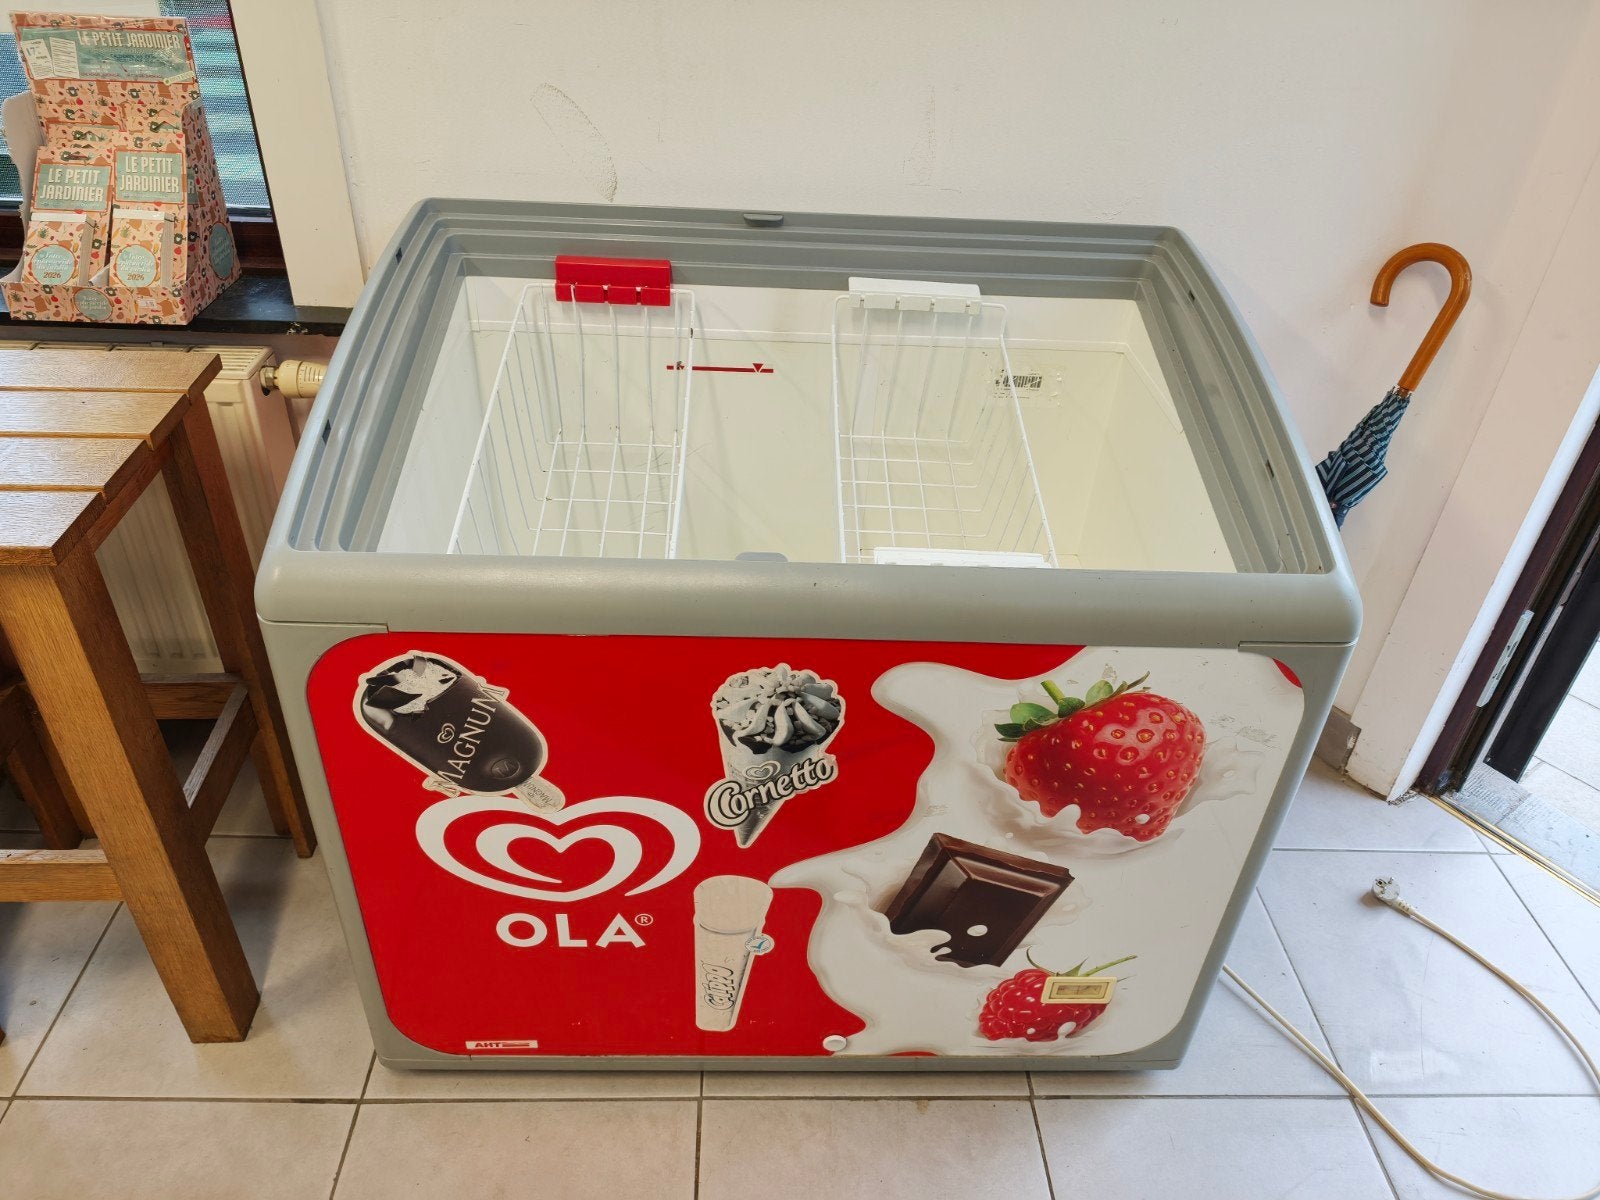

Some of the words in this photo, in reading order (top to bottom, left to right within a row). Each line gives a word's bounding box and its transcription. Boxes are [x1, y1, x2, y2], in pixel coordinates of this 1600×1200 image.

[77, 31, 88, 46] LE
[91, 31, 123, 47] PETIT
[126, 32, 181, 49] JARDINIER
[125, 156, 139, 173] LE
[141, 156, 173, 174] PETIT
[48, 168, 63, 184] LE
[65, 169, 100, 185] PETIT
[119, 175, 179, 193] JARDINIER
[40, 185, 104, 202] JARDINIER
[127, 273, 145, 281] 2026
[433, 683, 506, 798] MAGNUM
[708, 758, 834, 828] Cornetto
